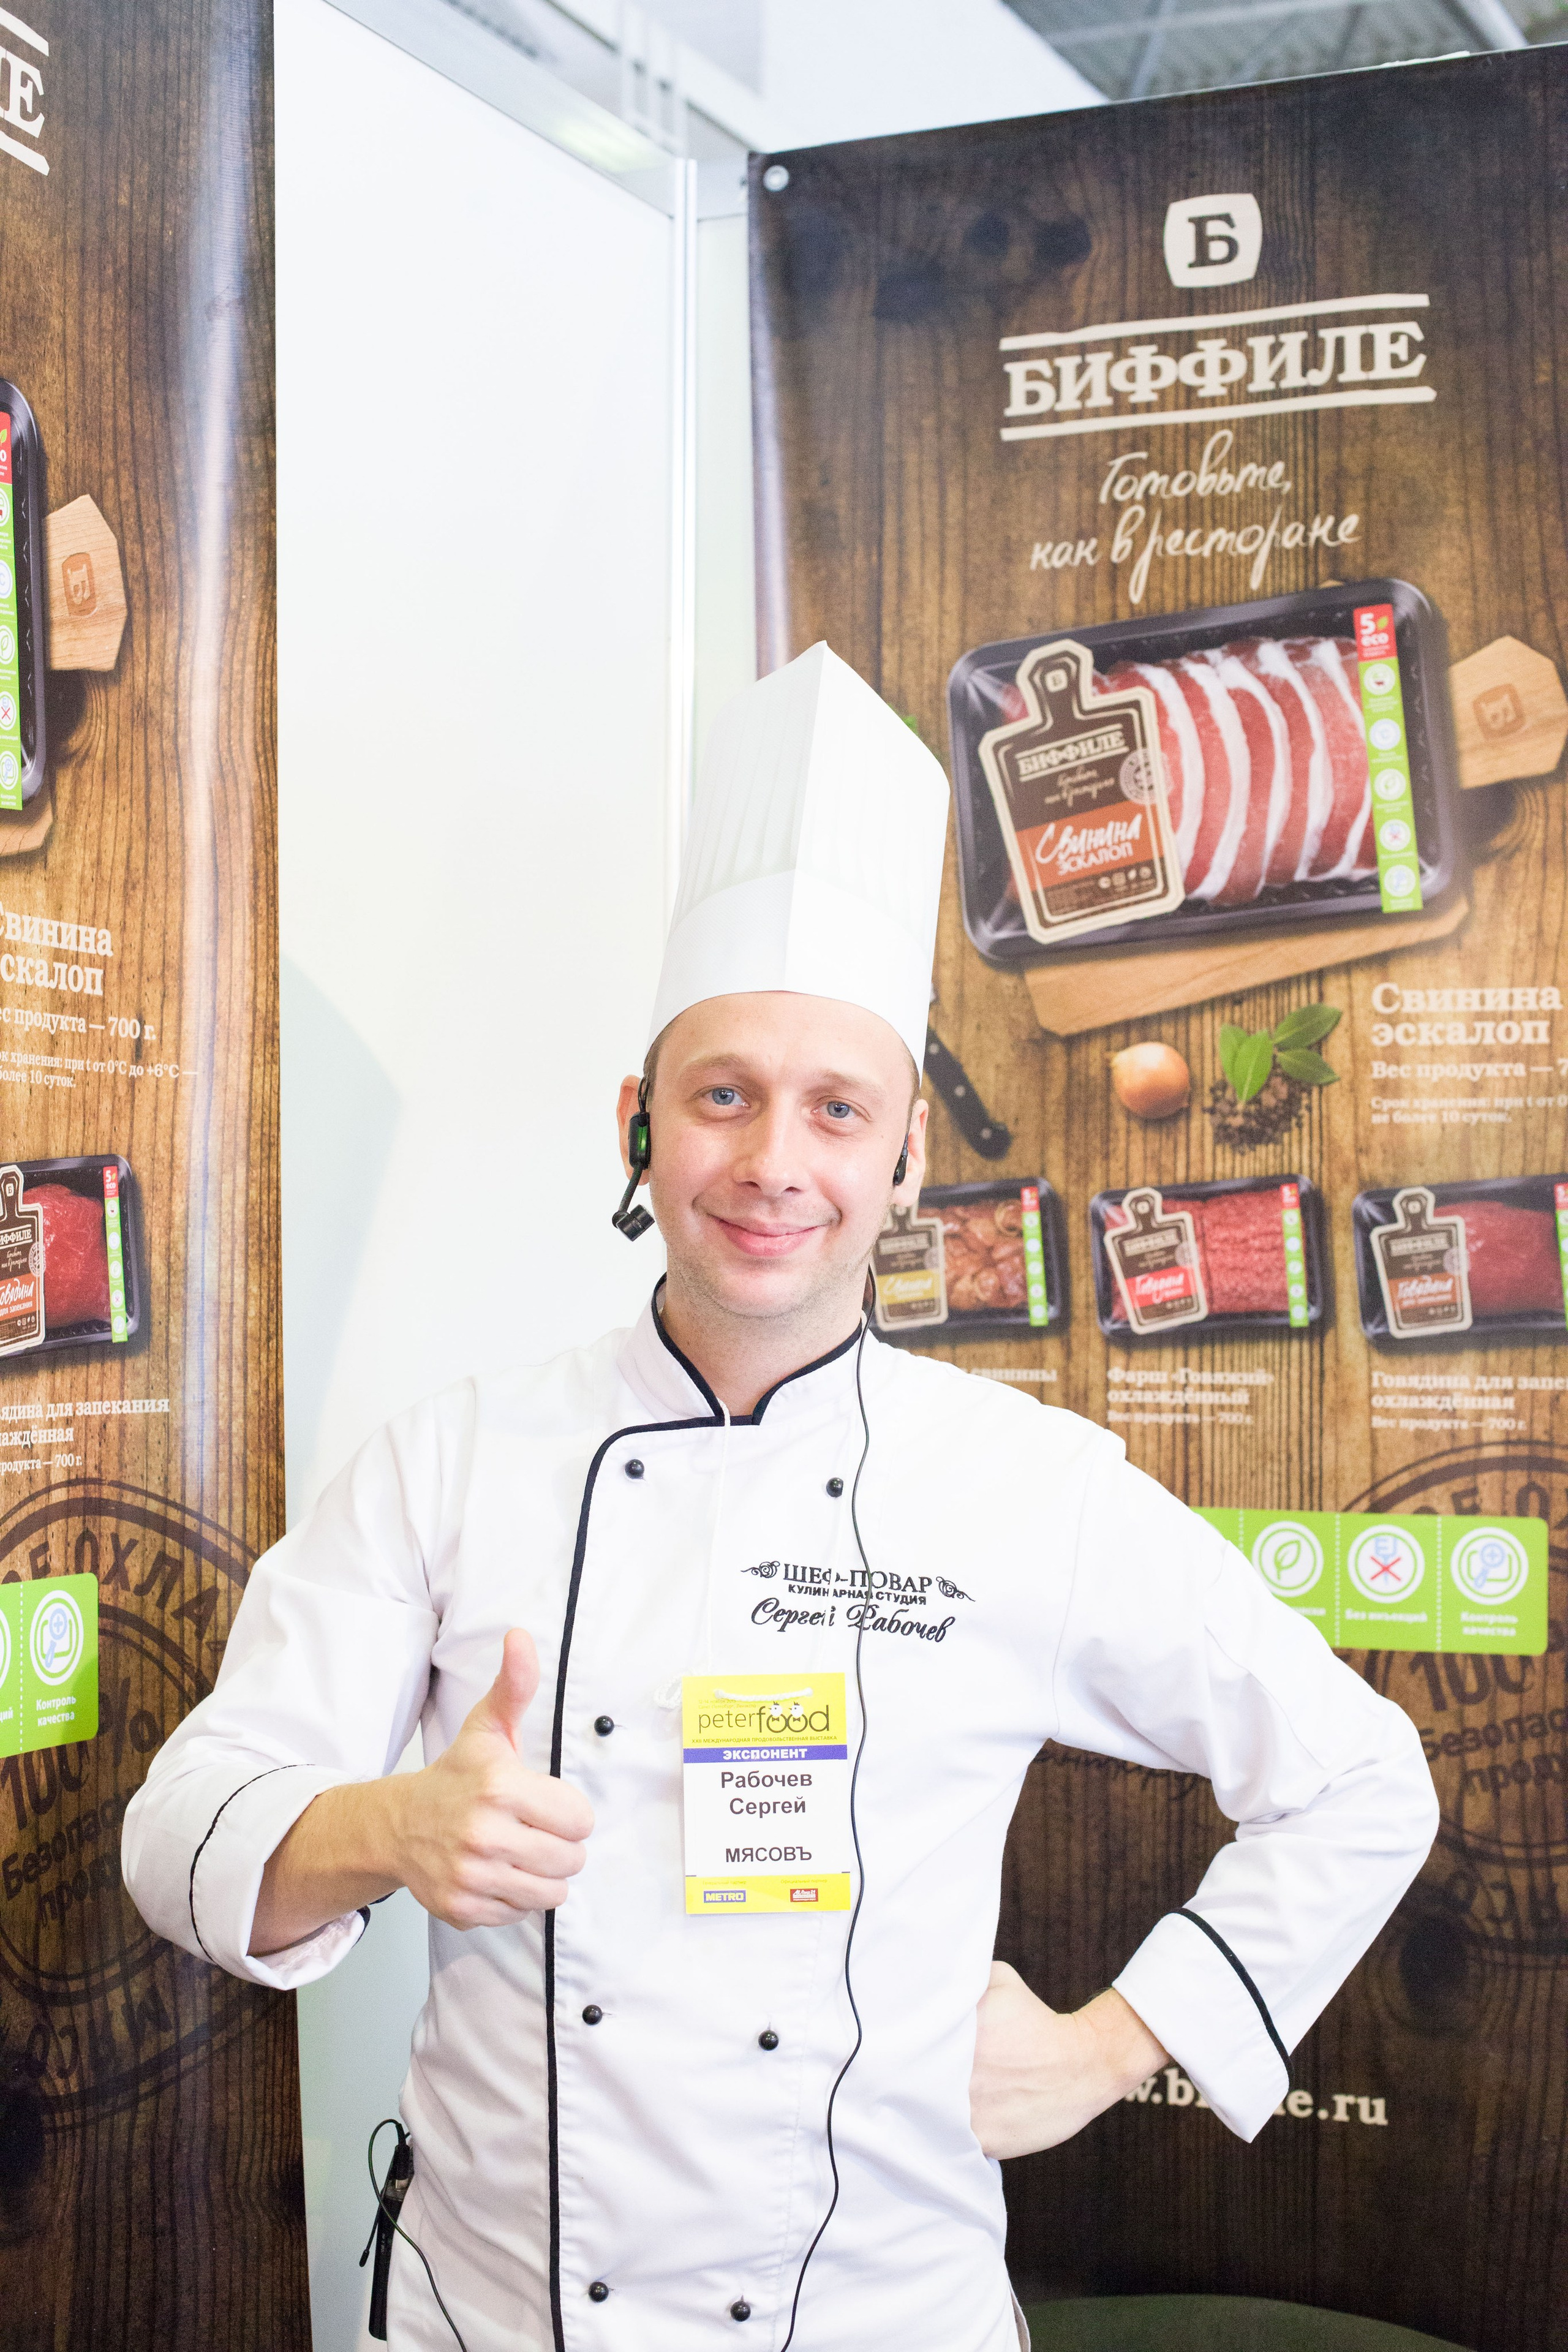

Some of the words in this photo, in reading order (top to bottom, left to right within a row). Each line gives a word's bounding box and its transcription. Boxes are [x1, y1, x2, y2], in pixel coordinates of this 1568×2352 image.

[1188, 213, 1239, 268] Б
[1004, 321, 1427, 417] БИФФИЛЕ
[1099, 430, 1291, 503] Готовьте,
[1031, 537, 1098, 570] как
[1111, 505, 1145, 563] в
[1129, 505, 1360, 603] ресторане
[1360, 612, 1376, 635] 5
[1361, 632, 1389, 647] eco
[1035, 813, 1143, 864] Свинина
[0, 953, 104, 996] скалоп
[1371, 982, 1563, 1014] Свинина
[14, 1008, 87, 1035] продукта
[108, 1016, 140, 1039] 700
[144, 1025, 156, 1041] г.
[1371, 1020, 1551, 1046] эскалоп
[10, 1053, 63, 1069] хранения:
[64, 1058, 84, 1072] при
[92, 1061, 106, 1072] от
[129, 1064, 144, 1077] до
[1371, 1060, 1411, 1079] Вес
[1417, 1063, 1526, 1082] продукта
[29, 1069, 42, 1085] 10
[43, 1075, 77, 1089] суток.
[1442, 1110, 1460, 1123] 10
[106, 1170, 111, 1182] 5
[0, 1228, 32, 1245] ИФФИЛЕ
[0, 1403, 43, 1423] ядина
[45, 1402, 73, 1421] для
[76, 1398, 170, 1416] запекания
[0, 1425, 74, 1449] аждённая
[0, 1458, 42, 1476] родукта
[55, 1453, 72, 1468] 700
[76, 1455, 83, 1466] г.
[876, 1591, 927, 1605] СТУДИЯ
[36, 1695, 77, 1711] Контроль
[37, 1711, 75, 1727] качества
[699, 1705, 829, 1734] peterfood
[723, 1748, 808, 1761] ЭКСПОНЕНТ
[721, 1771, 813, 1789] Рабочев
[729, 1795, 807, 1818] Сергей
[725, 1846, 812, 1863] МЯСОВЪ
[706, 1892, 744, 1902] METRO
